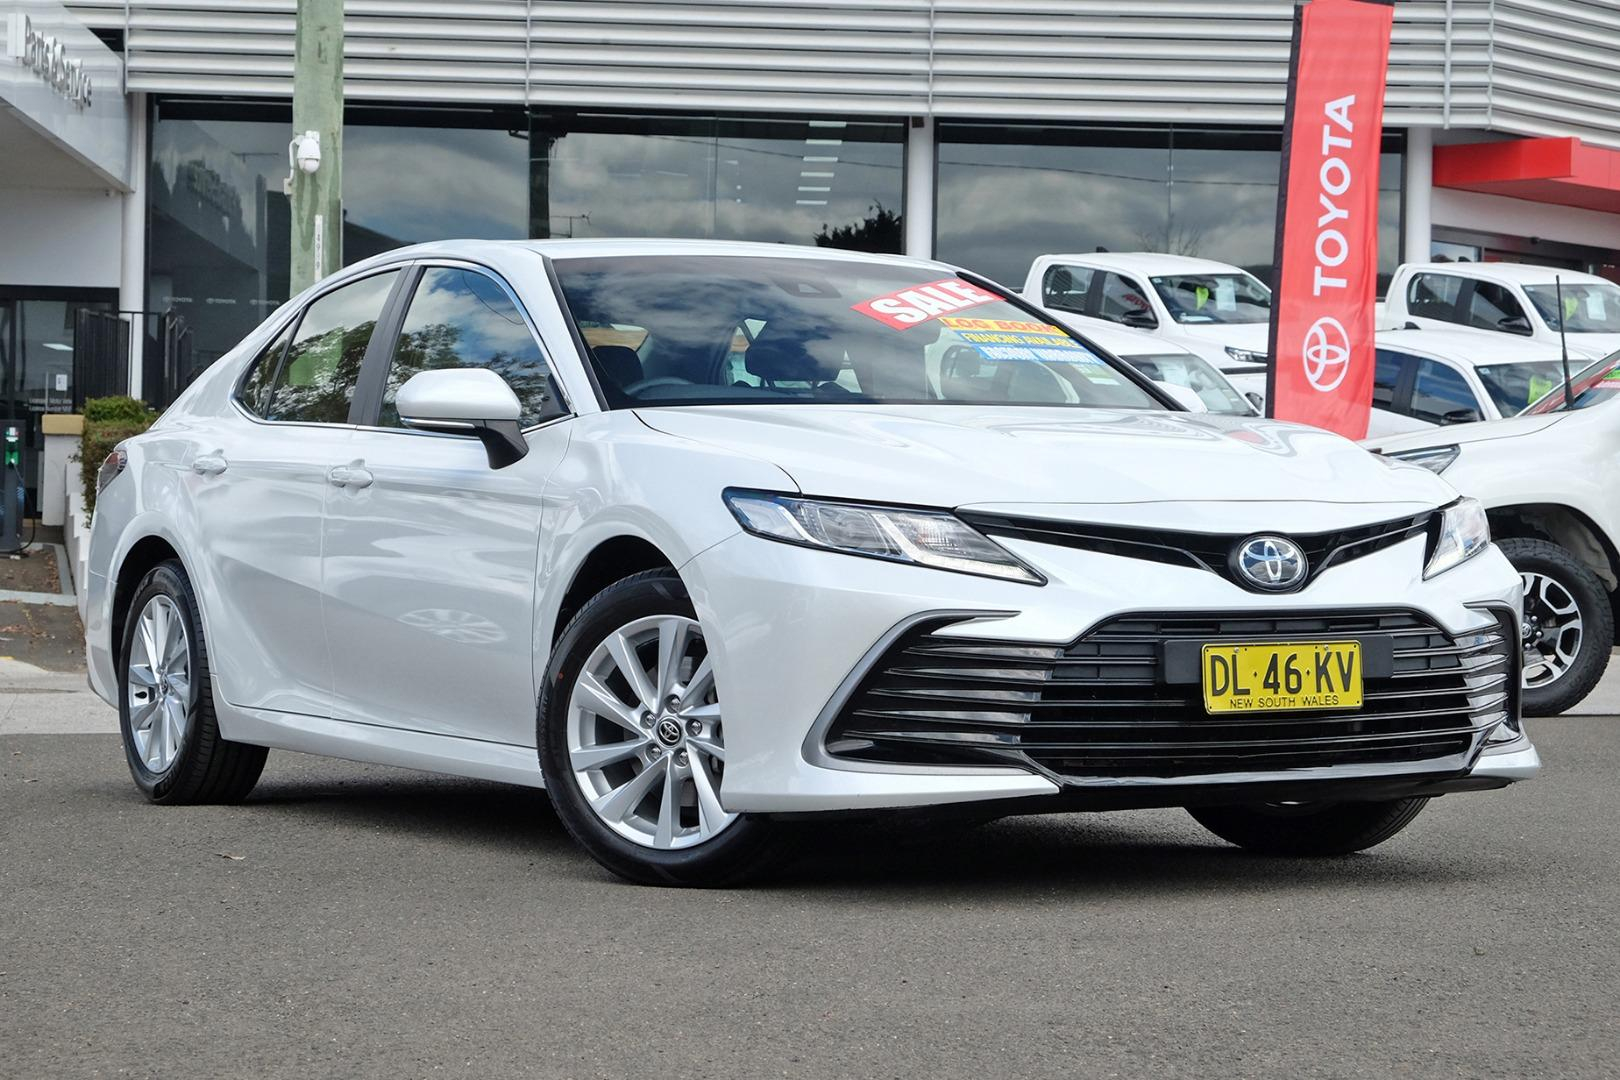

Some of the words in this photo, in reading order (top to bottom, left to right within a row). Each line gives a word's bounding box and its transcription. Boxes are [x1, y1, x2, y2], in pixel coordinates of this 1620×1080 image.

[24, 14, 50, 78] Parts
[57, 43, 92, 108] Service
[1313, 94, 1356, 296] TOYOTA
[870, 281, 994, 323] SALE
[944, 318, 992, 329] LOG
[994, 320, 1055, 333] BOOK
[1210, 652, 1251, 697] DL
[1262, 652, 1303, 695] 46
[1314, 650, 1355, 693] KV
[1229, 697, 1254, 709] NEW
[1258, 696, 1296, 708] SOUTH
[1302, 695, 1339, 706] WALES
